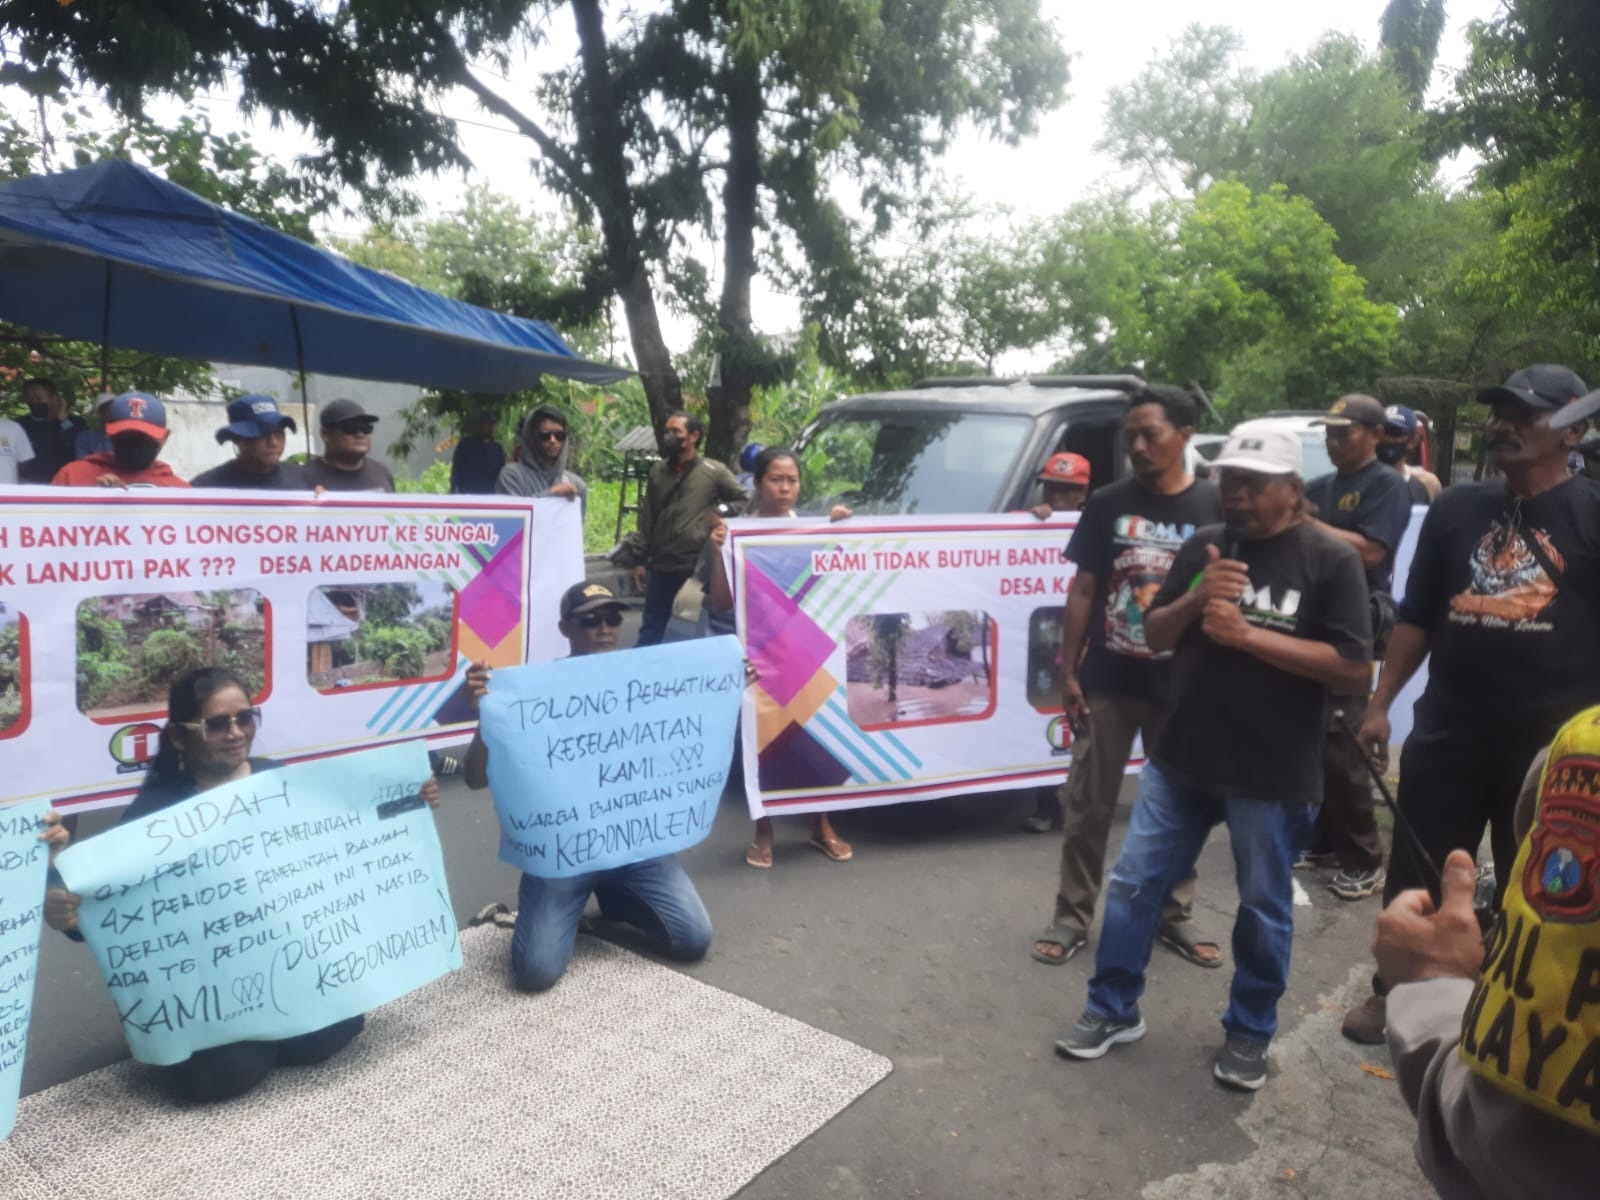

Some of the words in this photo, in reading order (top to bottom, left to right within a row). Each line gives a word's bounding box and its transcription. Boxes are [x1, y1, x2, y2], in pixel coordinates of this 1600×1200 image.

[19, 525, 132, 548] BANYAK
[141, 524, 177, 545] YG
[186, 524, 299, 545] LONGSOR
[305, 524, 389, 544] HANYUT
[396, 525, 417, 543] KE
[424, 524, 497, 545] SUNGAI,
[814, 551, 866, 573] KAMI
[874, 550, 930, 570] TIDAK
[938, 549, 1001, 569] BUTUH
[26, 559, 134, 585] LANJUTI
[144, 557, 191, 579] PAK
[200, 556, 236, 577] ???
[260, 555, 312, 574] DESA
[320, 552, 460, 573] KADEMANGAN
[1000, 577, 1046, 596] DESA
[509, 689, 618, 730] TOLONG
[626, 671, 742, 713] PERHATIKAN
[547, 714, 703, 768] KESELAMATAN
[145, 779, 290, 856] SUDAH
[508, 805, 579, 830] WARGA
[107, 930, 190, 969] DERITA
[334, 866, 355, 886] INI
[363, 851, 414, 875] TIDAK
[152, 877, 249, 926] PERIODE
[255, 848, 339, 894] PEMERINTAH
[107, 970, 149, 989] ADA
[213, 921, 291, 968] PEDULI
[376, 867, 429, 896] NASIB
